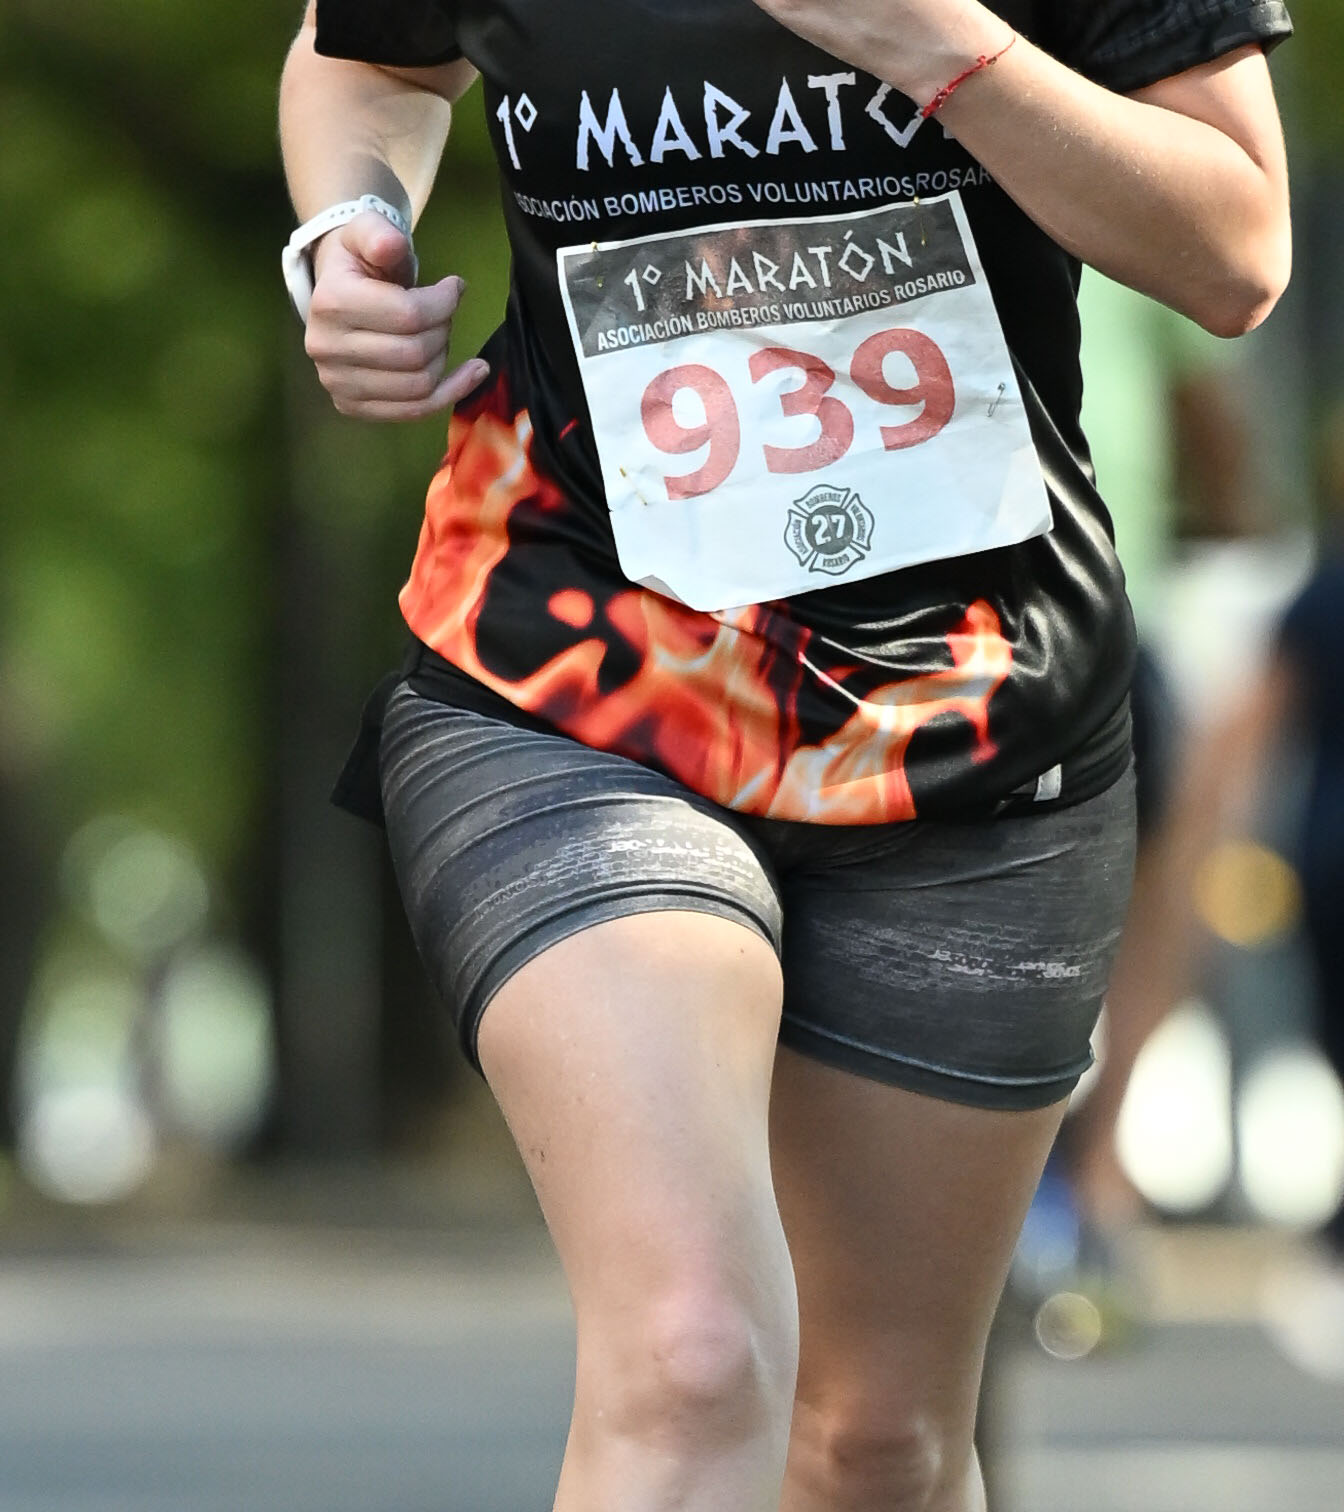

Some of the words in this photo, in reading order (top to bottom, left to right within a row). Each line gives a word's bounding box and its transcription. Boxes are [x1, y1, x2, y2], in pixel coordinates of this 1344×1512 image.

[604, 183, 744, 218] BOMBEROS
[746, 175, 917, 204] VOLUNTARIOS
[684, 229, 913, 301] MARATÓN
[597, 313, 693, 351] ASOCIACIÓN
[695, 304, 781, 330] BOMBEROS
[782, 290, 892, 320] VOLUNTARIOS
[894, 269, 966, 301] ROSARIO
[640, 327, 956, 501] 939
[811, 514, 846, 546] 27
